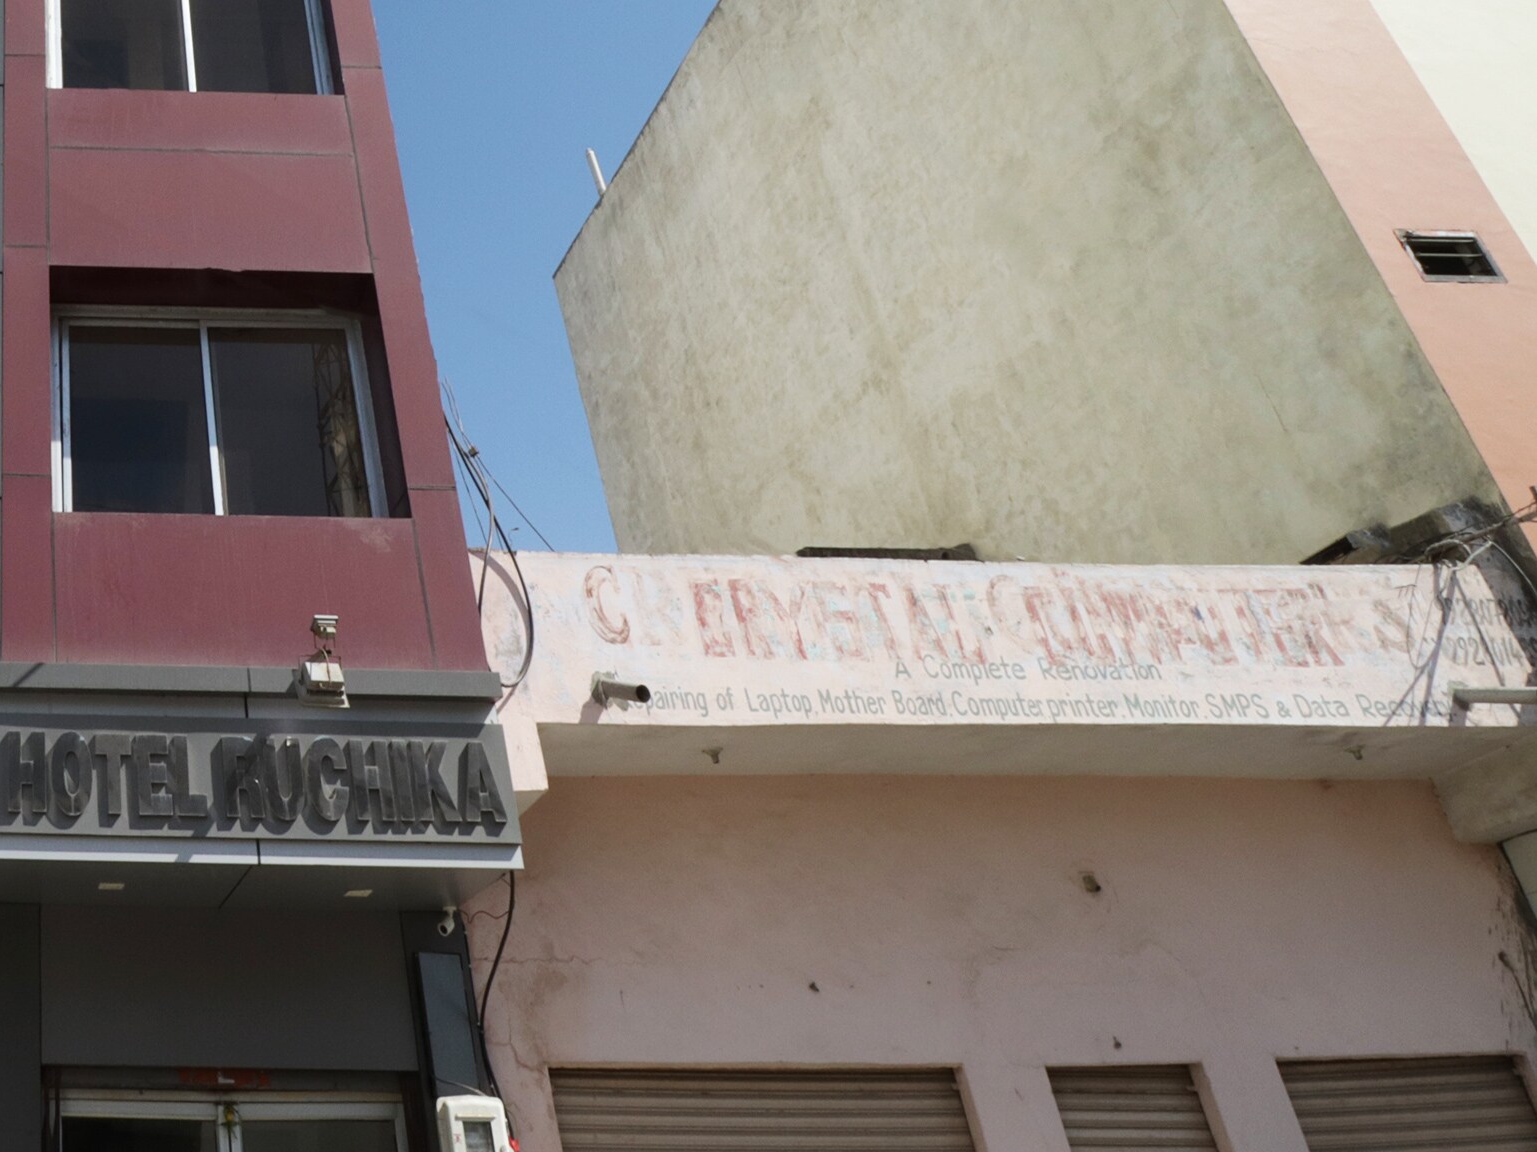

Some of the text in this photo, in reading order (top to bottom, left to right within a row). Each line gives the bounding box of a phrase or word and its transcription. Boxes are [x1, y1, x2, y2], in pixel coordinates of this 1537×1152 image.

[895, 654, 1162, 686] A Complete Renovation
[715, 688, 735, 711] of
[1203, 694, 1270, 719] SMPS
[1277, 700, 1292, 718] &
[1292, 694, 1350, 719] Data
[0, 731, 508, 826] HOTEL RUCHIKA
